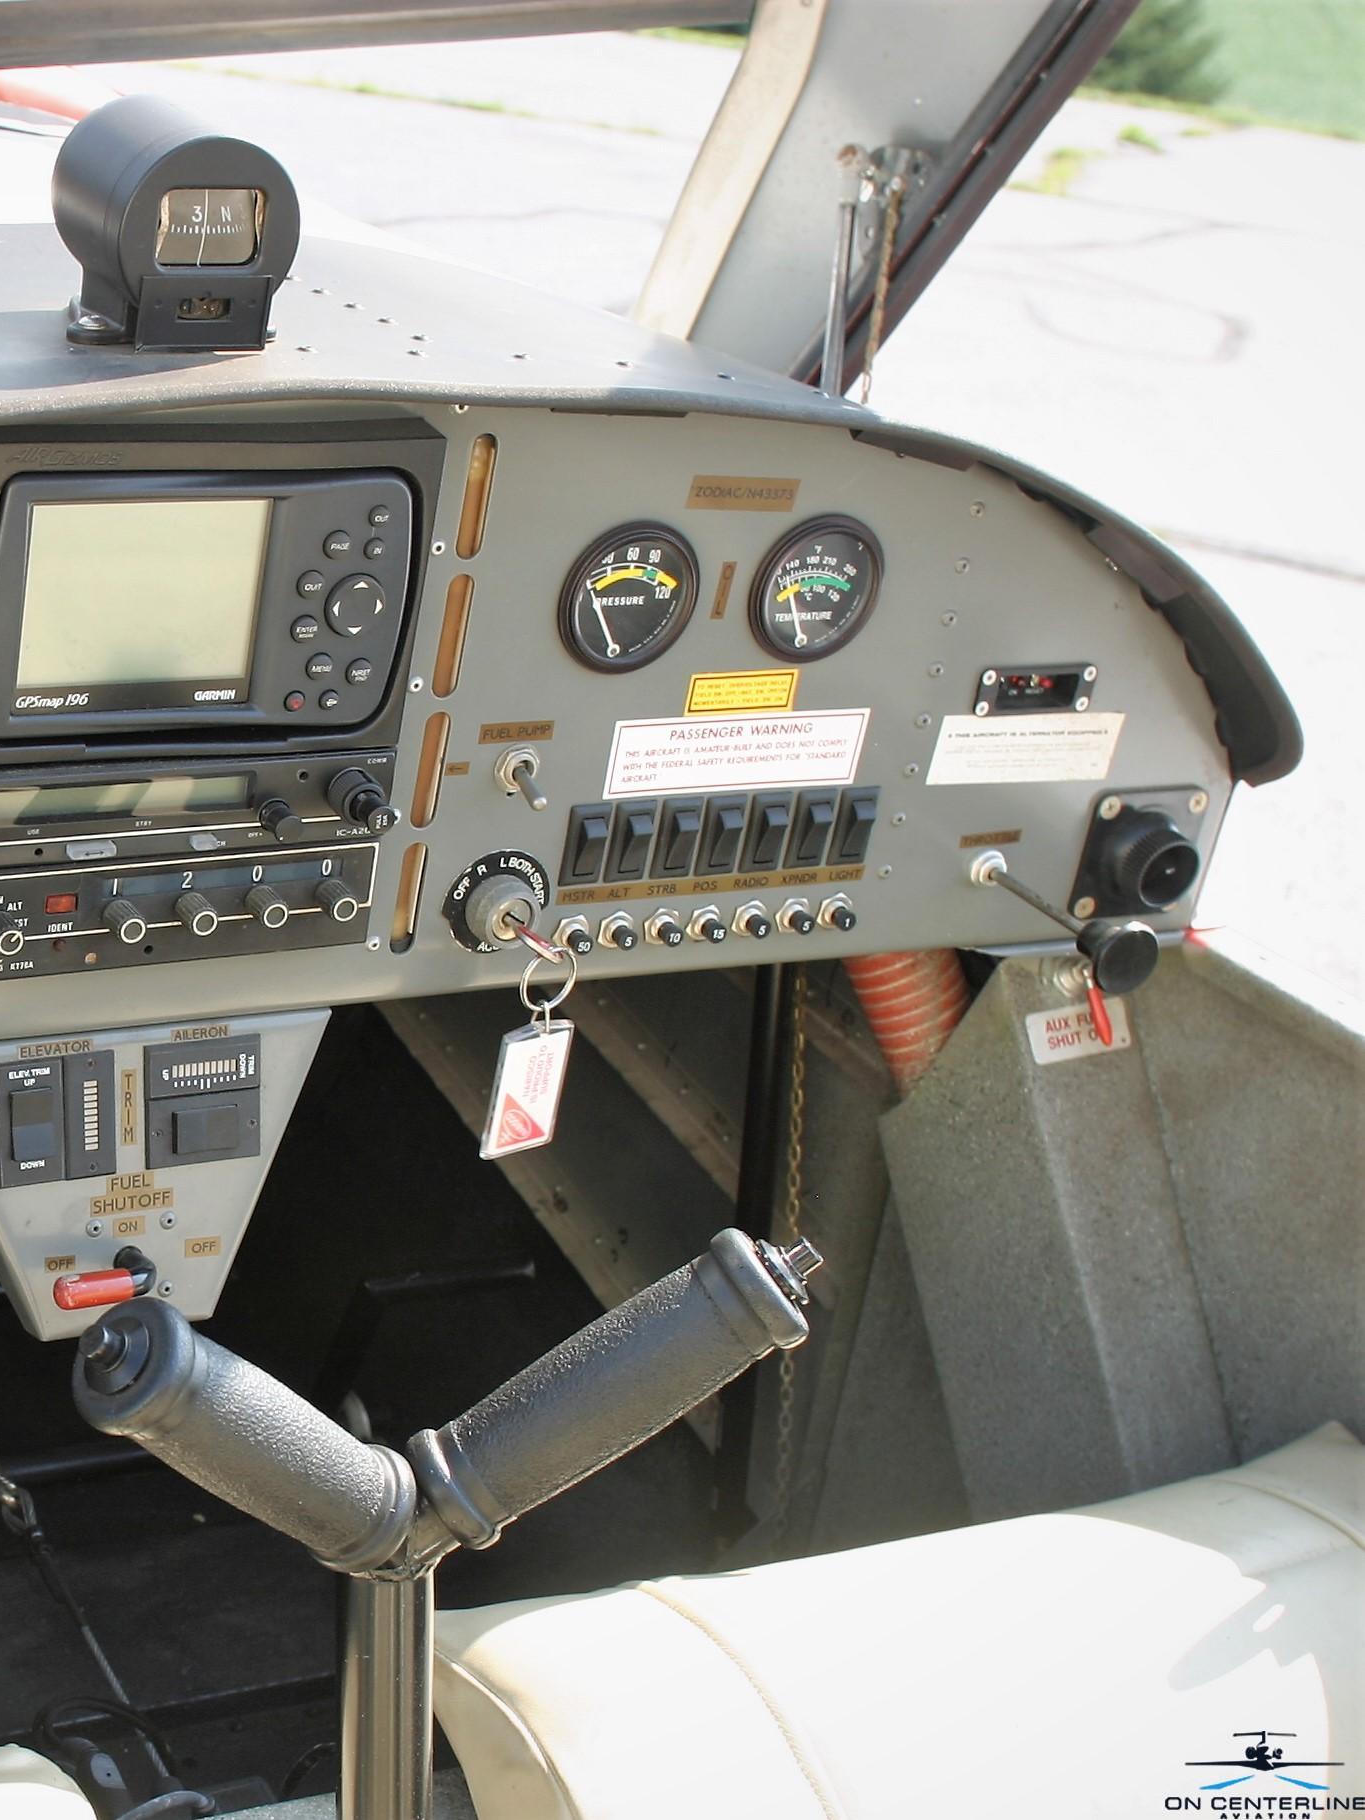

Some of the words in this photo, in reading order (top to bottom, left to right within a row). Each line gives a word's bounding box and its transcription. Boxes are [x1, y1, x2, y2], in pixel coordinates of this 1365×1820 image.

[192, 205, 203, 222] 3
[220, 205, 232, 222] N
[627, 547, 640, 561] 60
[649, 549, 662, 563] 90
[655, 586, 671, 599] 120
[15, 694, 63, 709] GPSmap
[65, 692, 90, 706] 196
[194, 689, 236, 702] GARMIN
[482, 728, 511, 740] FUEL
[518, 726, 552, 738] PUMP
[669, 726, 744, 741] PASSENGER
[750, 722, 814, 736] WARNING
[644, 747, 681, 757] AIRCRAFT
[755, 742, 773, 750] AND
[775, 741, 795, 749] DOES
[799, 740, 814, 748] NOT
[697, 758, 723, 766] SAFETY
[476, 863, 487, 877] R
[500, 857, 508, 868] L
[508, 856, 535, 877] BOTH
[181, 871, 193, 889] 2
[252, 864, 263, 882] 0
[321, 858, 332, 876] 0
[453, 876, 471, 901] OFF
[529, 872, 545, 905] START
[562, 888, 595, 901] MSTR
[607, 887, 630, 899] ALT
[646, 883, 677, 896] STRB
[692, 879, 718, 892] POS
[734, 876, 770, 889] RADIO
[780, 872, 818, 886] XPNDR
[828, 868, 862, 881] LIGHT
[6, 901, 23, 912] ALT
[47, 921, 74, 933] IDENT
[577, 941, 591, 952] 50
[625, 936, 633, 947] 5
[669, 932, 681, 943] 10
[713, 929, 726, 940] 15
[758, 925, 767, 936] 5
[802, 920, 810, 932] 5
[845, 918, 850, 928] 1
[1045, 1016, 1071, 1033] AUX
[173, 1025, 229, 1042] AILERON
[1047, 1032, 1082, 1050] SHUT
[20, 1040, 91, 1059] ELEVATOR
[23, 1078, 36, 1087] UP
[123, 1073, 134, 1143] TRIM
[20, 1159, 45, 1170] DOWN
[110, 1174, 151, 1191] FUEL
[92, 1191, 171, 1214] SHUTOFF
[118, 1221, 138, 1234] ON
[191, 1240, 217, 1254] OFF
[47, 1258, 74, 1271] OFF
